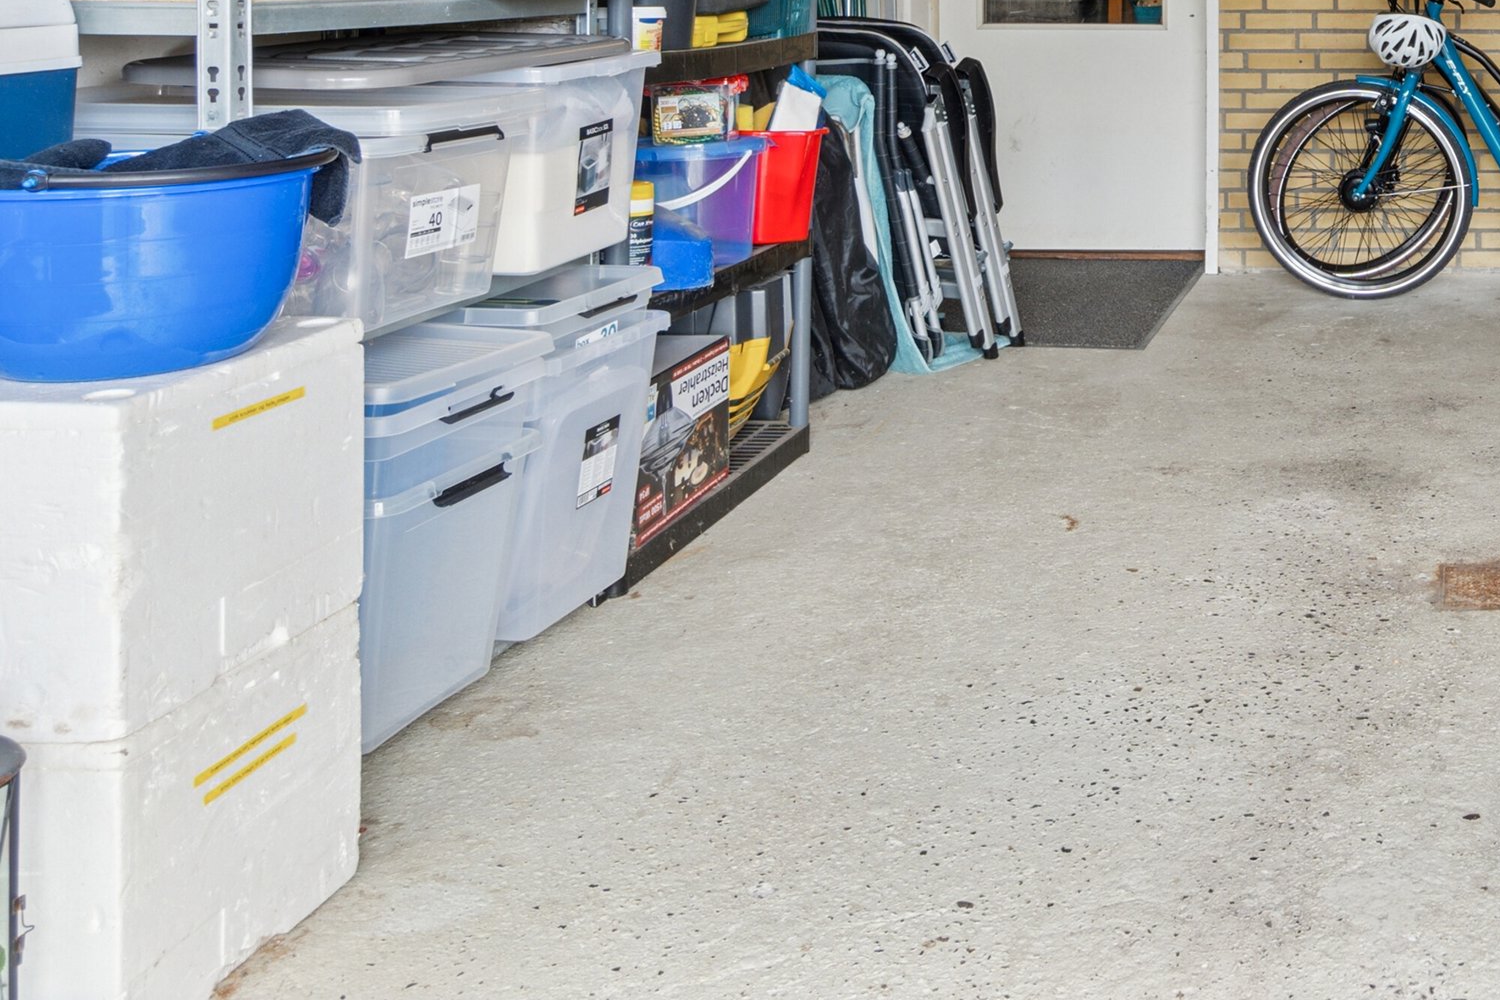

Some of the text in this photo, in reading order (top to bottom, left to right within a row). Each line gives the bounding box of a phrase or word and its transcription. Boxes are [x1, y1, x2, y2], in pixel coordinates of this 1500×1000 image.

[428, 211, 443, 227] 40
[678, 357, 729, 396] Heizstrahler
[691, 375, 729, 408] Decken
